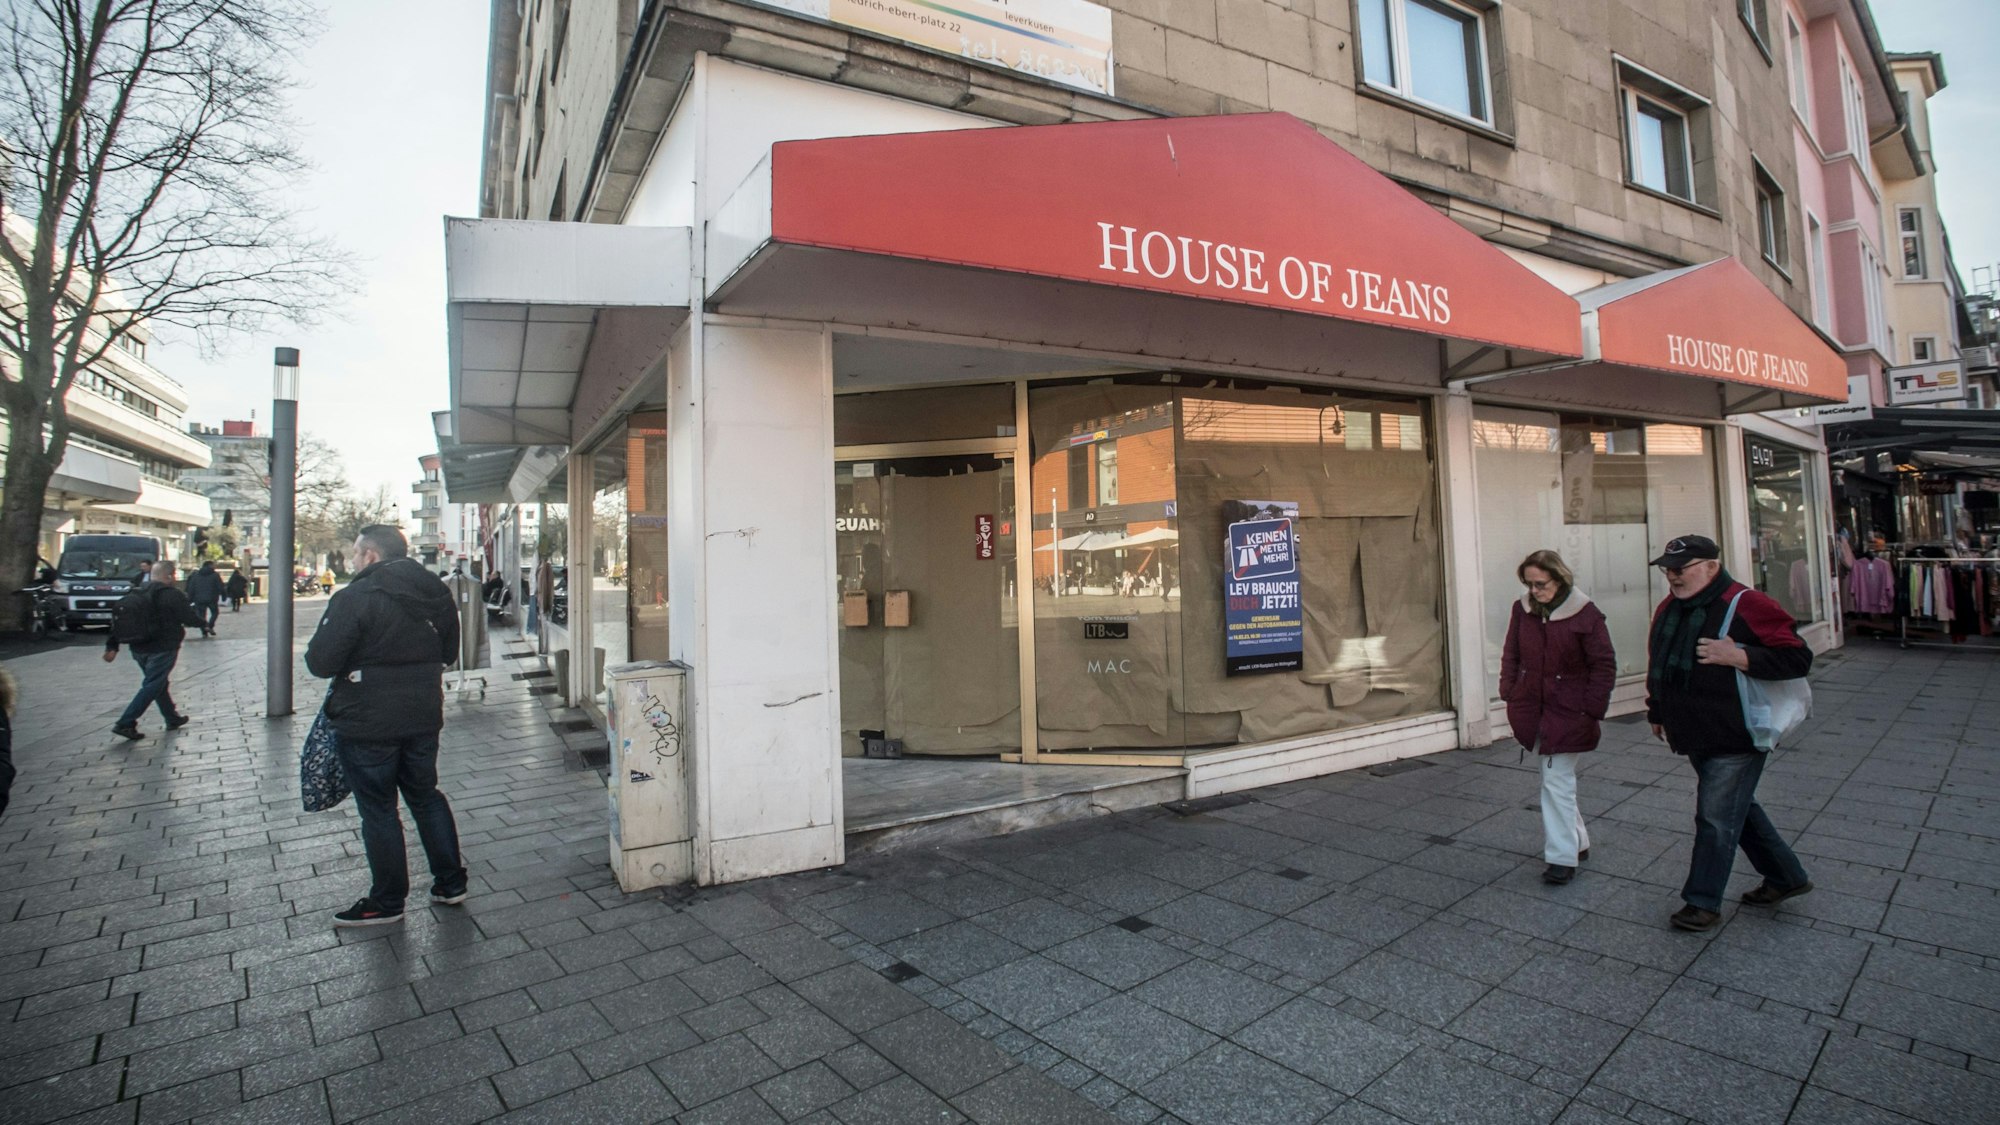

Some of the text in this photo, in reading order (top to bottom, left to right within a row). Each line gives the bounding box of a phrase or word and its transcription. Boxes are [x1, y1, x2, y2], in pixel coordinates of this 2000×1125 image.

[949, 22, 961, 34] 22
[1005, 11, 1055, 33] leverkusen
[1097, 222, 1451, 325] HOUSE OF JEANS
[1667, 334, 1809, 387] HOUSE OF JEANS
[1894, 371, 1958, 389] TLS
[1818, 406, 1866, 415] NetCologne
[1246, 530, 1287, 545] KEINEN
[1260, 542, 1288, 554] METER
[1263, 552, 1289, 564] MEHR!
[1229, 581, 1299, 595] LEV BRAUCHT
[1230, 594, 1298, 610] DICH JETZT!
[1086, 623, 1105, 638] LTB
[1087, 659, 1131, 674] MAC
